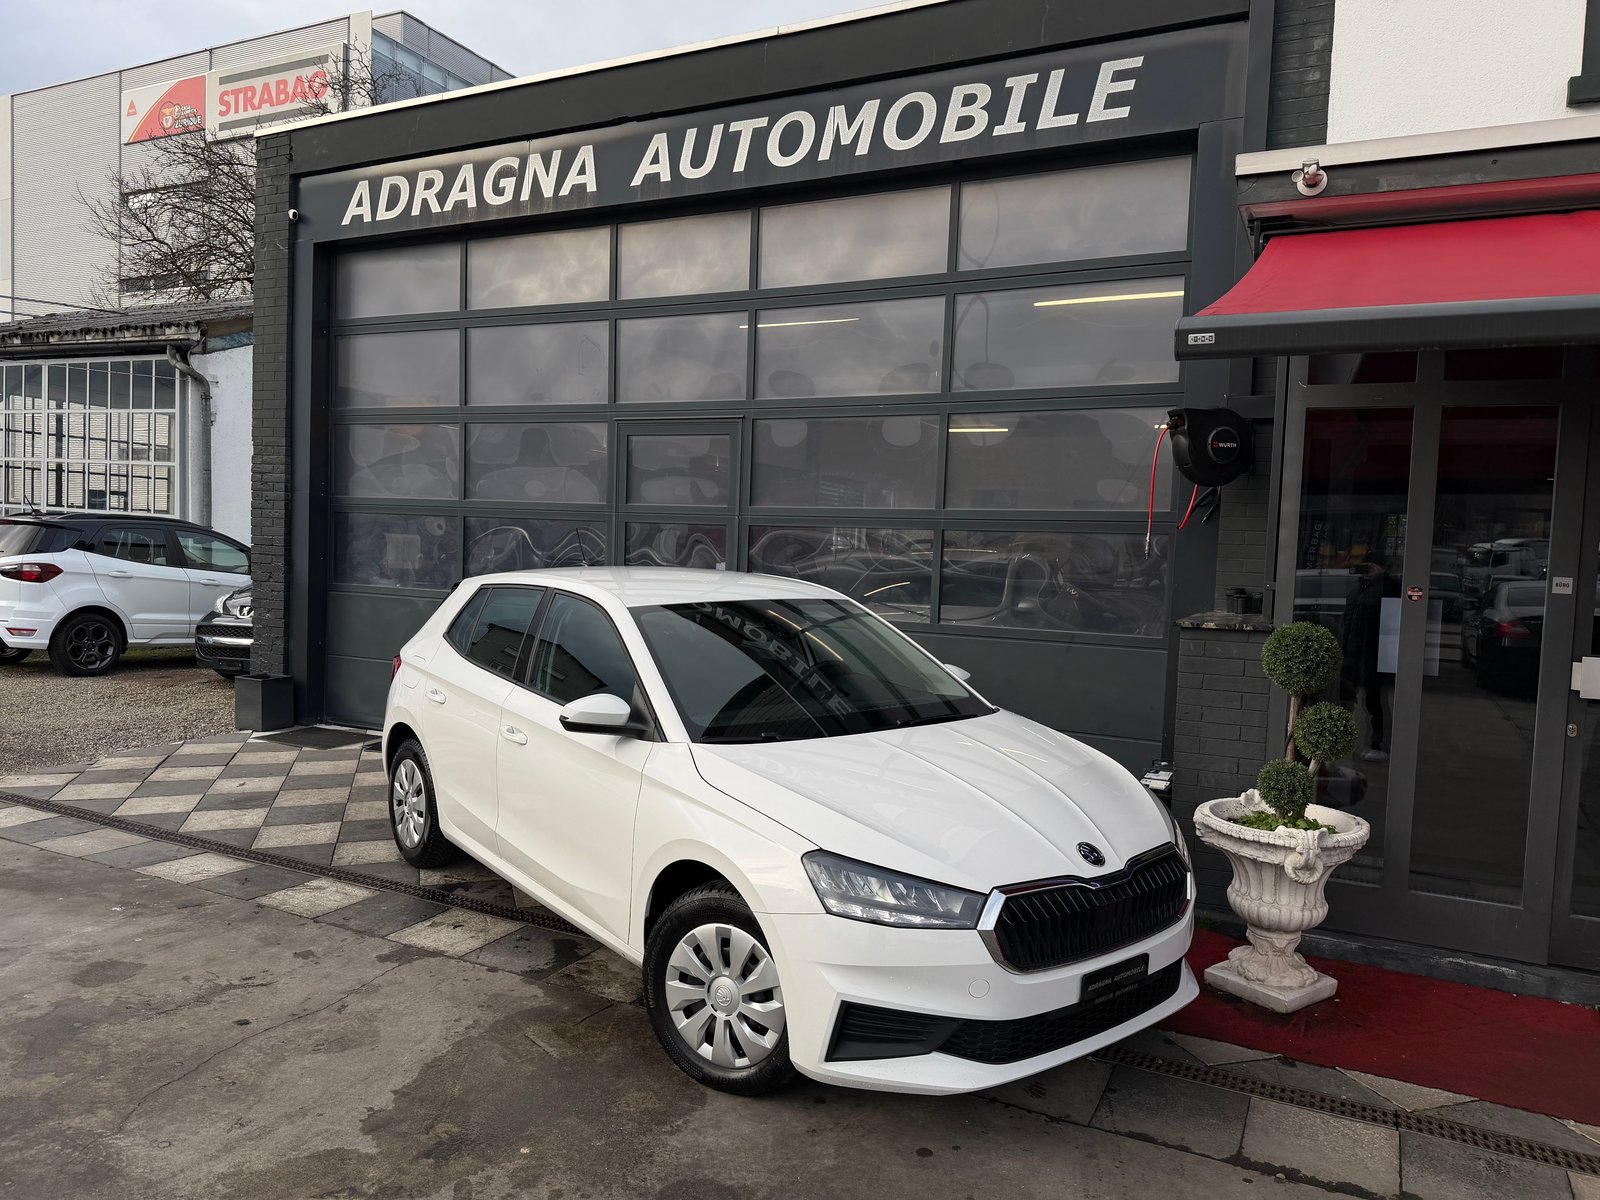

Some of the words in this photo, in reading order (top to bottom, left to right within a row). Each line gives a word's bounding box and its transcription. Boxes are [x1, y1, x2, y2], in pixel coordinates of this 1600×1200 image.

[218, 71, 328, 117] STRABAG
[341, 144, 597, 226] ADRAGNA
[629, 55, 1145, 187] AUTOMOBILE
